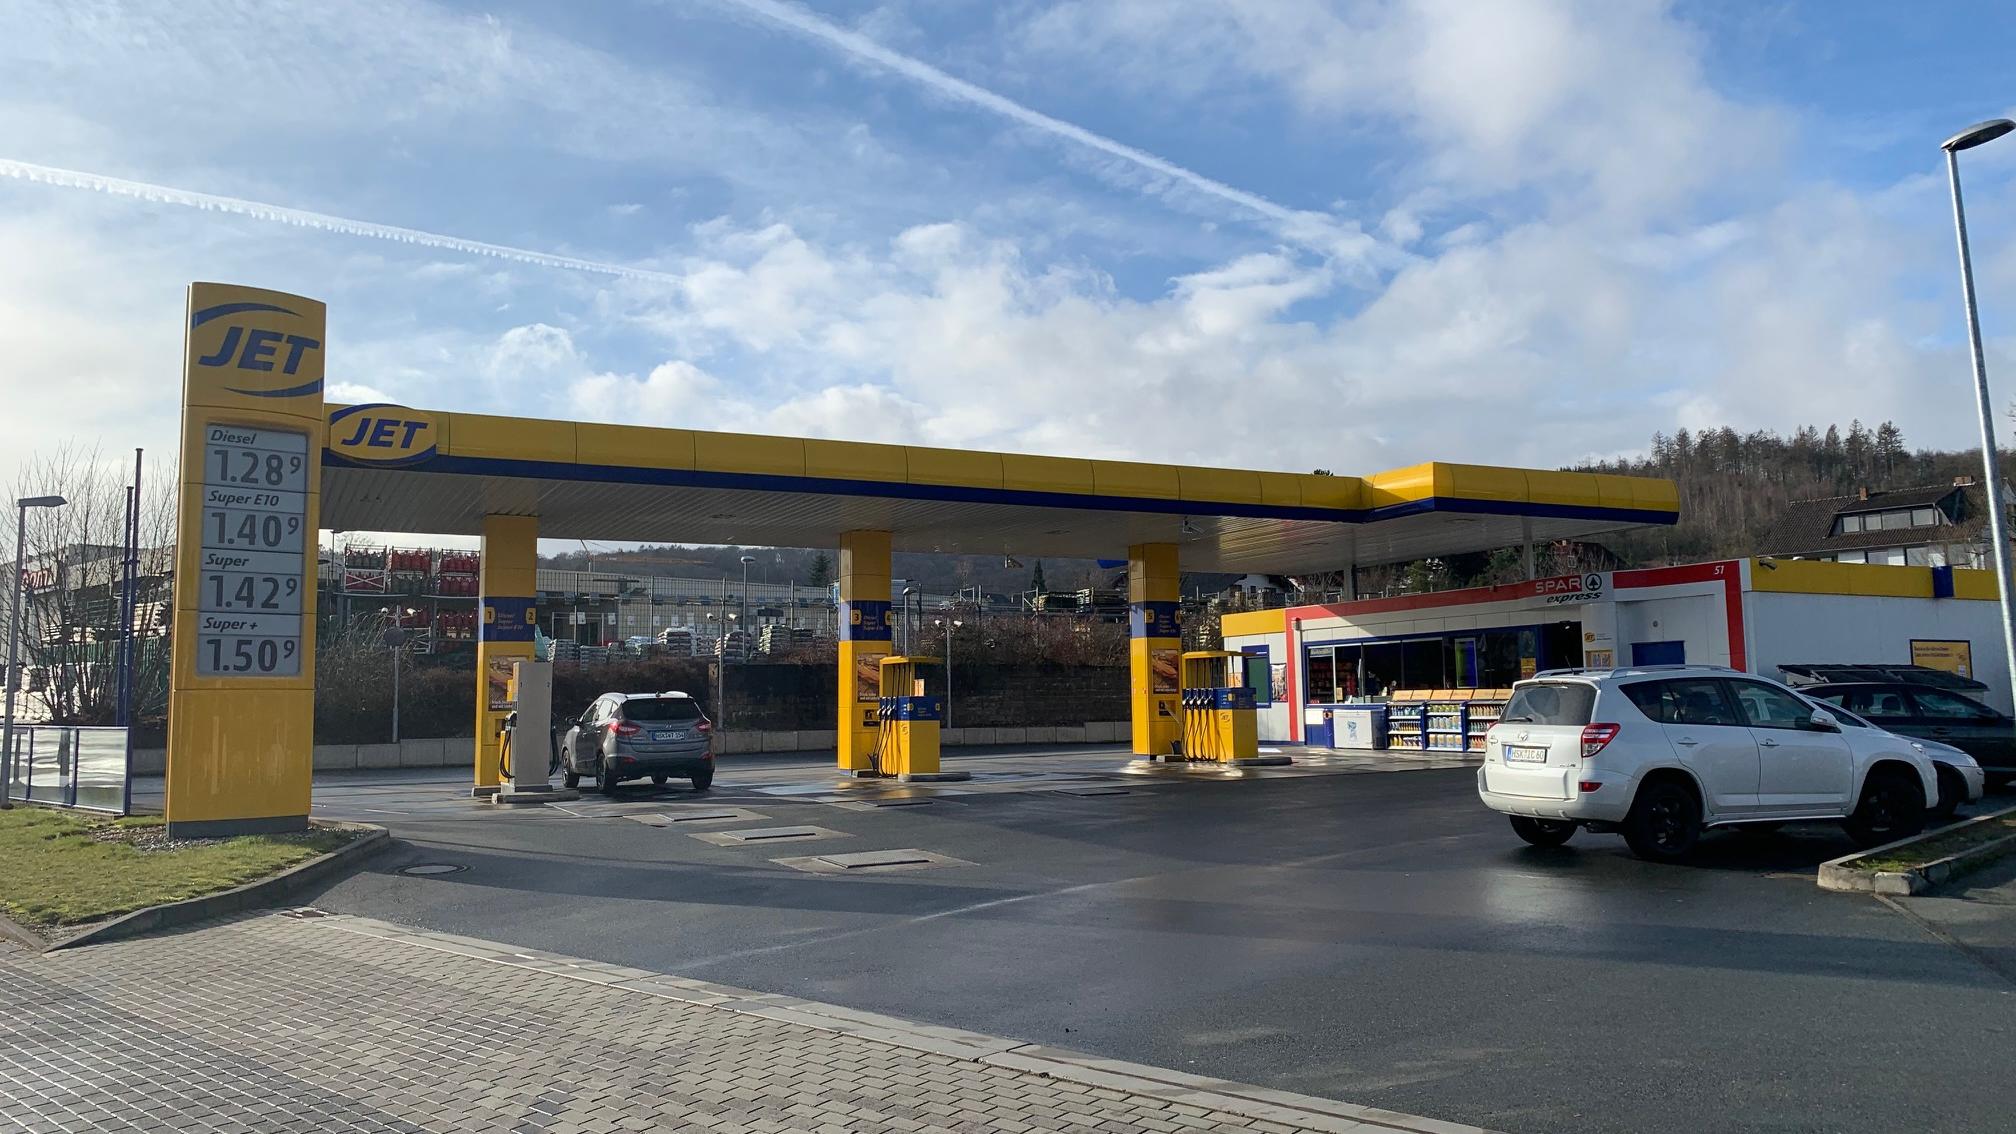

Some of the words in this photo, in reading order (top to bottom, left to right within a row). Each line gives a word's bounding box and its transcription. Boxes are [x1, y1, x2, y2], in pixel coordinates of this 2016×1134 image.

[198, 326, 321, 375] JET
[211, 429, 257, 446] Diesel
[341, 418, 428, 449] JET
[208, 490, 252, 506] Super
[253, 494, 279, 507] E10
[205, 552, 250, 569] Super
[1714, 565, 1725, 575] 51
[1535, 577, 1582, 593] SPAR
[1546, 591, 1603, 604] express
[203, 616, 248, 632] Super
